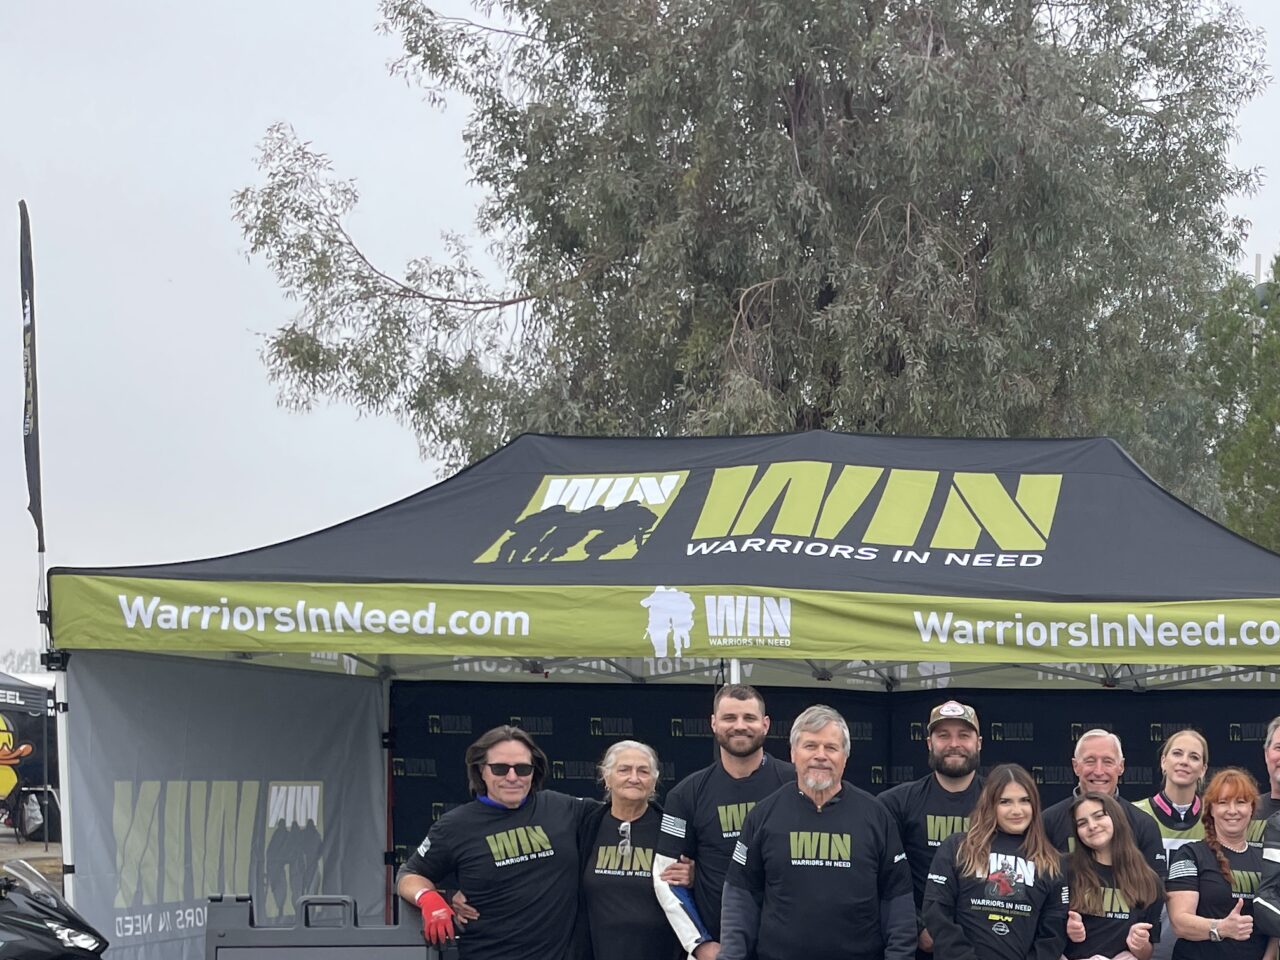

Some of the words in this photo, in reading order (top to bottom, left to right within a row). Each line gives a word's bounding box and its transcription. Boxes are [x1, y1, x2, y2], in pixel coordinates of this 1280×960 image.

[541, 475, 680, 512] WIN
[691, 461, 1063, 550] WIN
[686, 538, 878, 562] WARRIORS
[893, 549, 930, 564] IN
[945, 552, 1044, 567] NEED
[118, 594, 530, 636] WarriorsInNeed.com
[705, 595, 791, 637] WIN
[709, 638, 753, 646] WARRIORS
[486, 825, 552, 861] WIN
[495, 855, 529, 868] WARRIORS
[538, 849, 555, 858] NEED
[789, 832, 851, 861] WIN
[971, 898, 1004, 908] WARRIORS
[1006, 902, 1013, 910] IN
[1014, 903, 1032, 912] NEED
